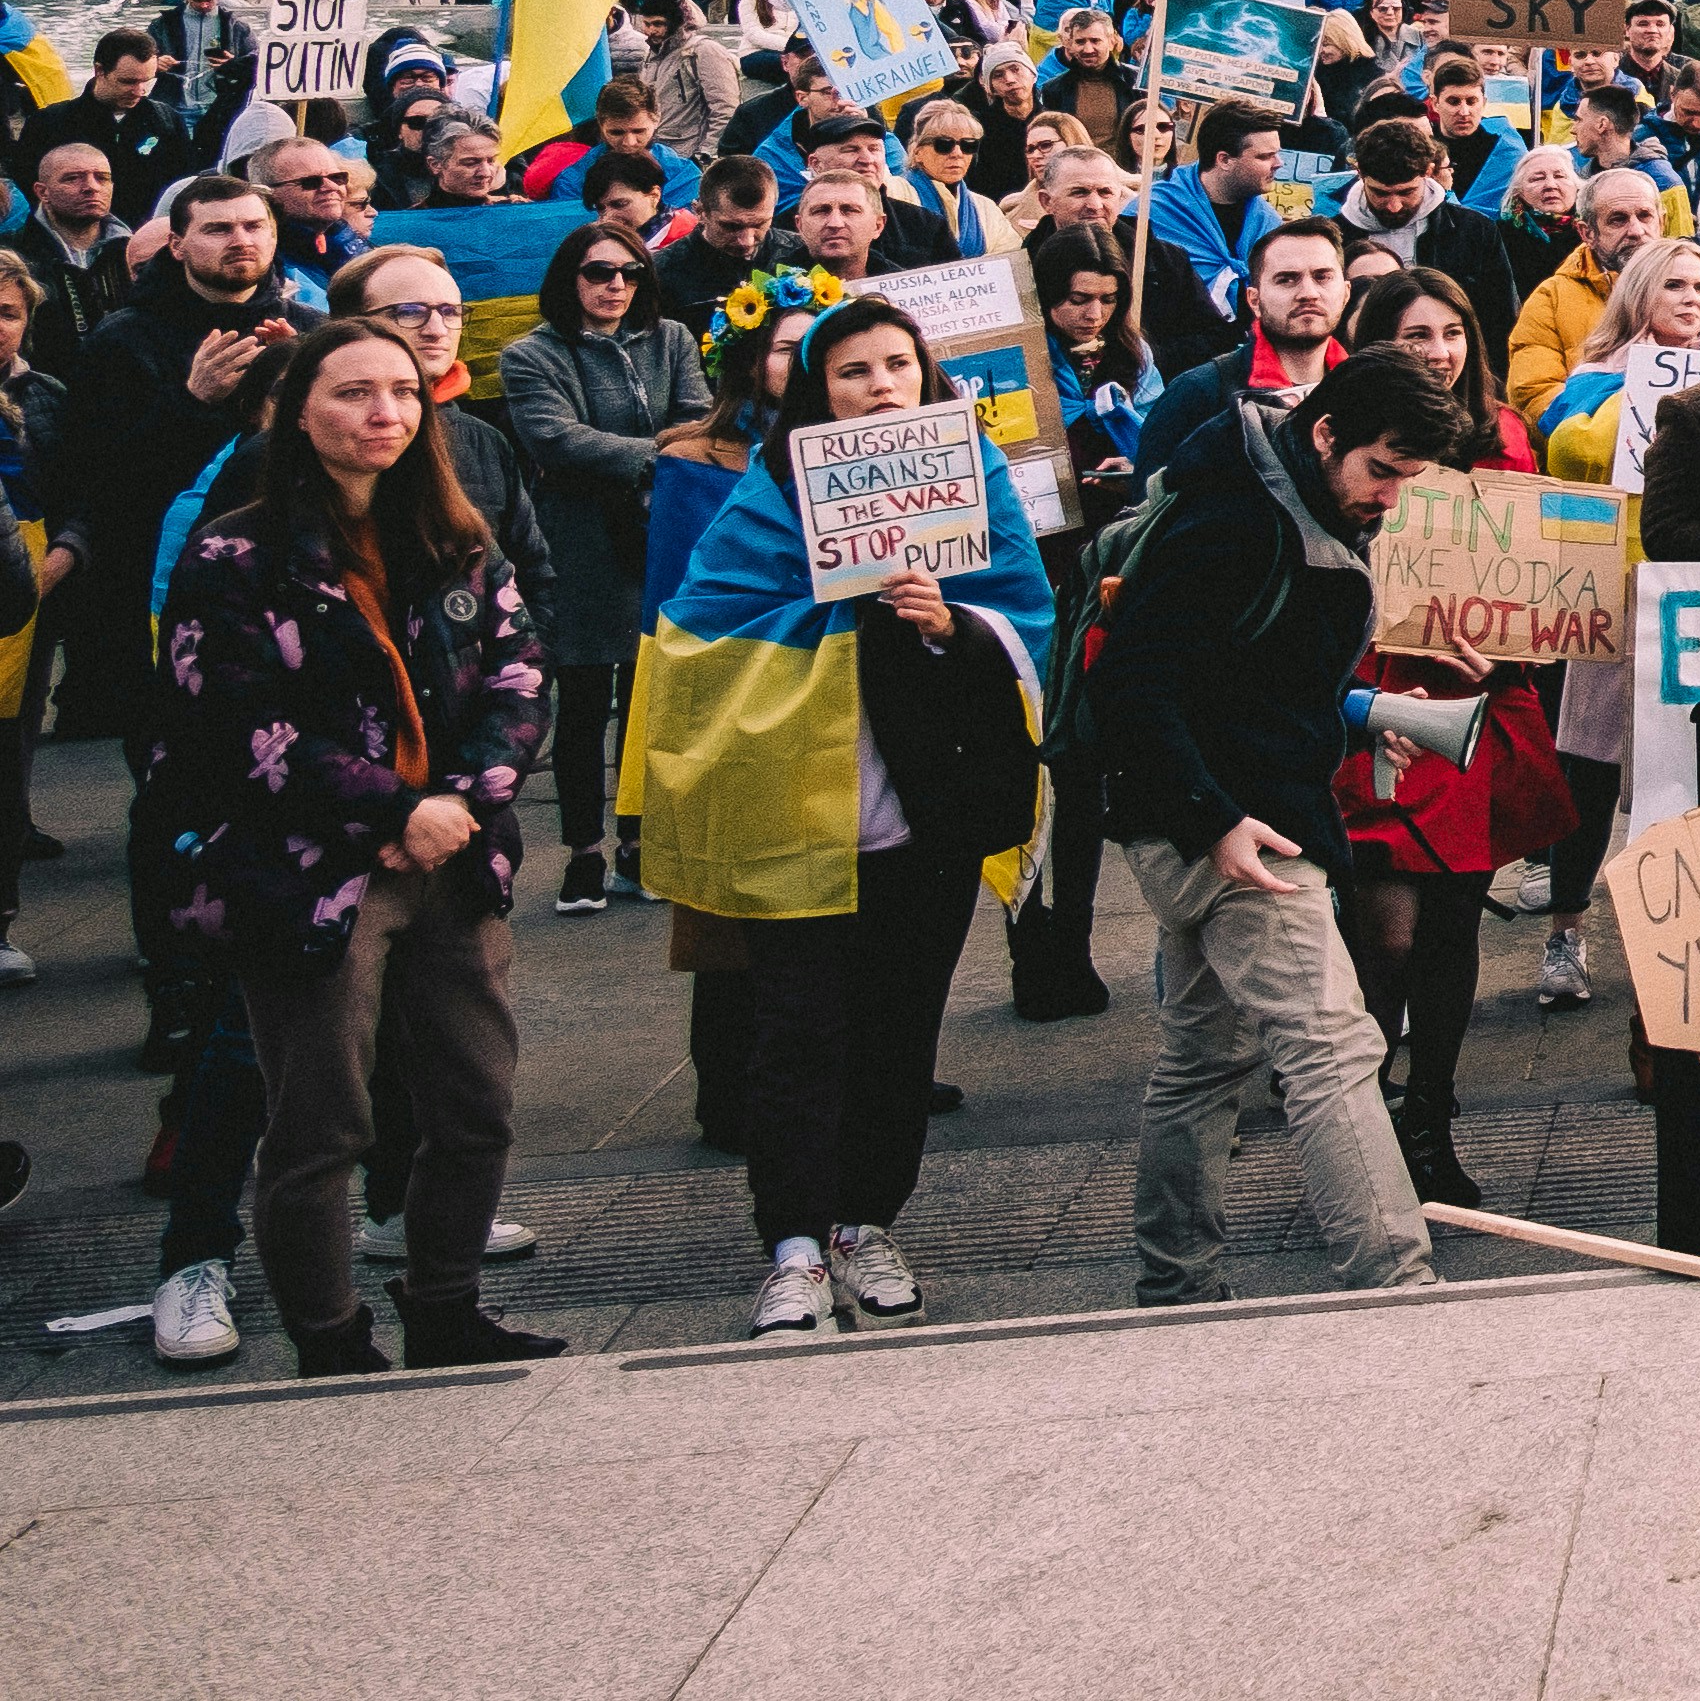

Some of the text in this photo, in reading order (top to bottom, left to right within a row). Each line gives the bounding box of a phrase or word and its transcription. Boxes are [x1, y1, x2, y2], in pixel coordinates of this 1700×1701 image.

[879, 263, 987, 293] RUSSIA, LEAVE
[899, 281, 998, 310] RAINE ALONE
[961, 311, 1003, 329] STATE
[822, 421, 939, 463] RUSSIAN
[826, 451, 955, 498] AGAINST
[837, 482, 968, 525] THE WAR
[1383, 486, 1515, 553] UTIN
[817, 525, 989, 572] STOP PUTIN
[1470, 556, 1601, 610] VODKA
[1422, 593, 1616, 655] NOT WAR
